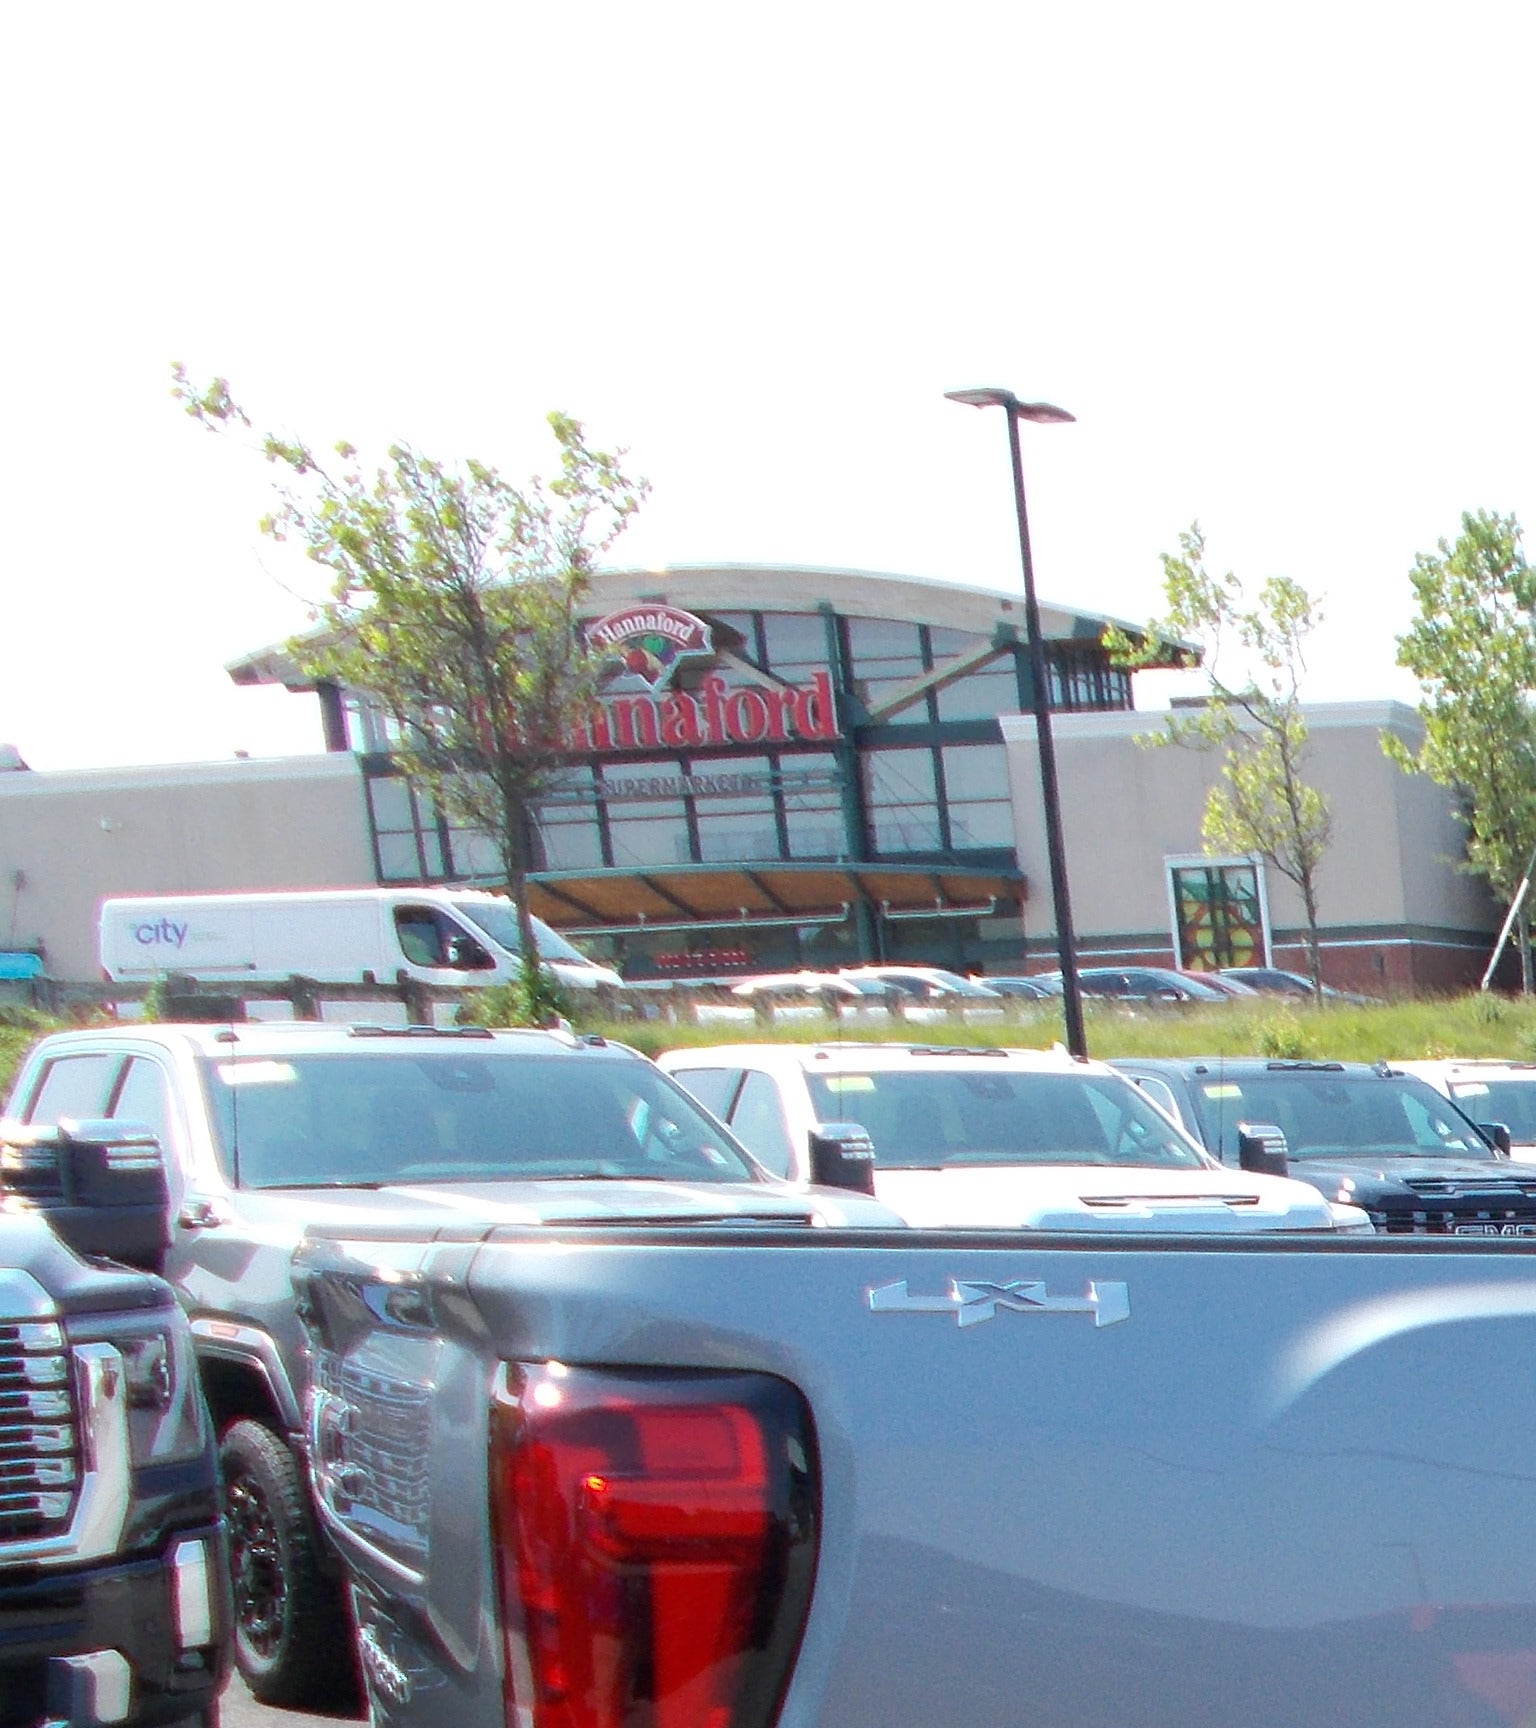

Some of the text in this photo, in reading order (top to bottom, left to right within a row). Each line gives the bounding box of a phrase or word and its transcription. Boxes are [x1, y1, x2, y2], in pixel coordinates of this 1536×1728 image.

[599, 612, 696, 645] Hannaford
[468, 672, 843, 752] nnaford
[135, 918, 189, 949] city
